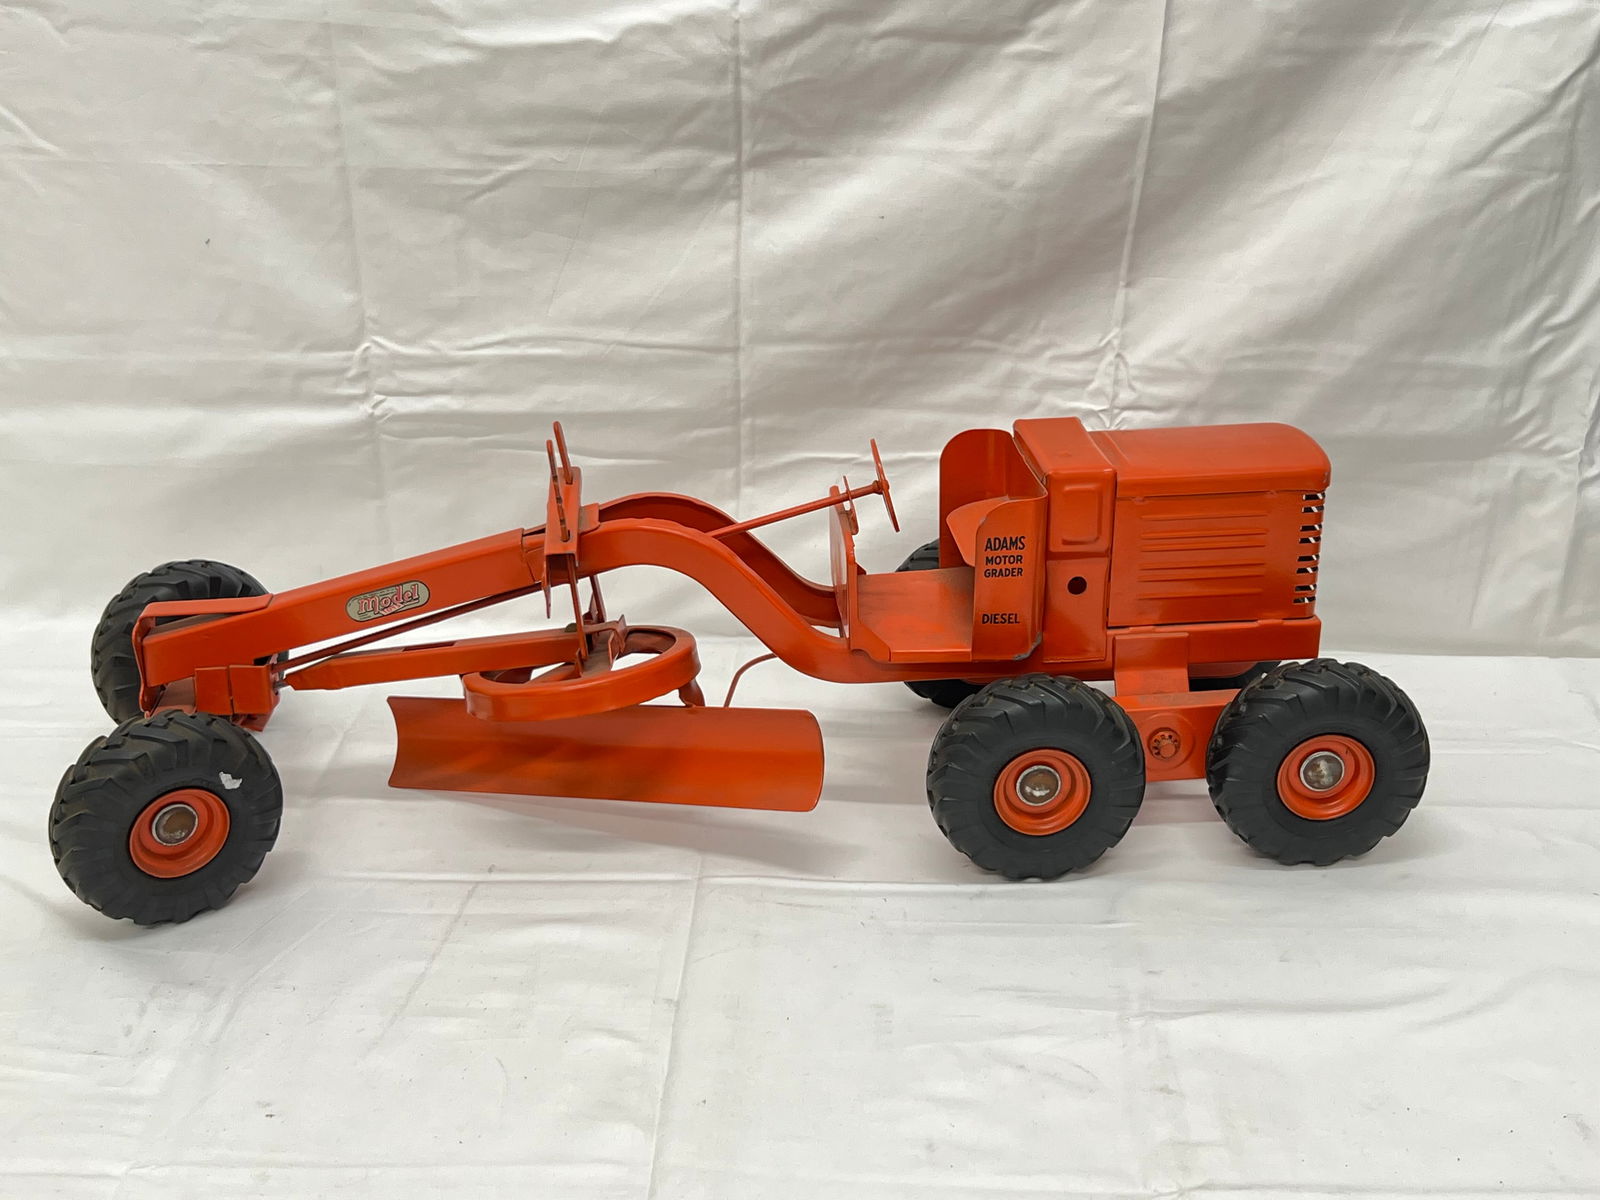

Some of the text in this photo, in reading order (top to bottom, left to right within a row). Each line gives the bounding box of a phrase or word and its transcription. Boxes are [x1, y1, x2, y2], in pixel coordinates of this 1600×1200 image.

[984, 536, 1026, 552] ADAMS
[985, 555, 1023, 566] MOTOR
[984, 567, 1023, 578] GRADER
[981, 613, 1020, 624] DIESEL
